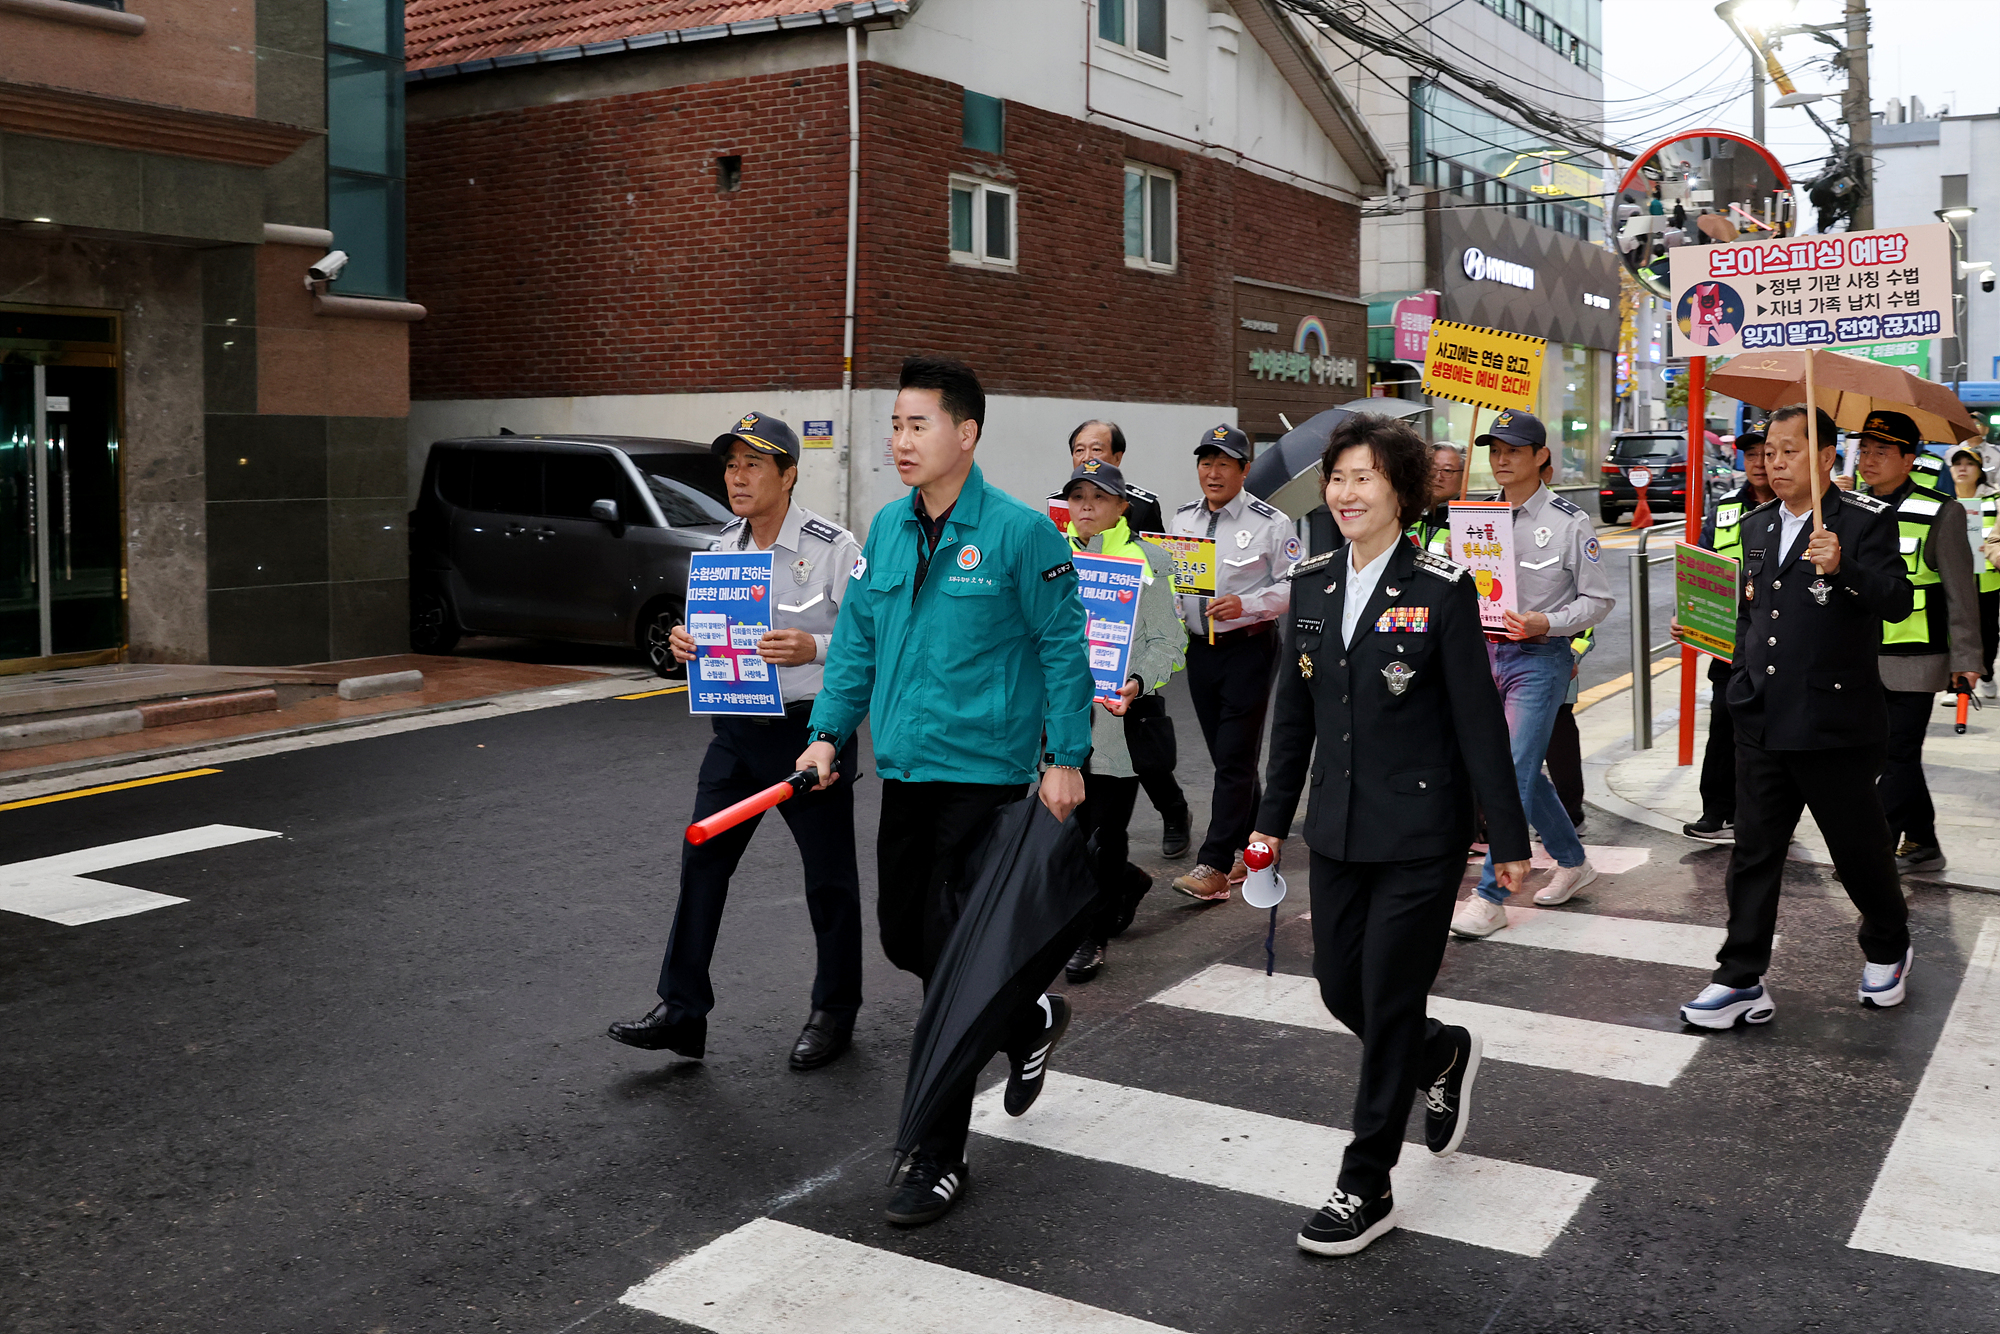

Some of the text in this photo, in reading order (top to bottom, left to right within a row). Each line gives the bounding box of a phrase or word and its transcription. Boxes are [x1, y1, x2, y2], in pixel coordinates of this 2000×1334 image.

[1710, 233, 1908, 277] 보이스피싱 예방
[1486, 257, 1534, 290] HYUNDAI
[1769, 267, 1919, 296] 정부 기관 사칭 수법
[1770, 289, 1920, 317] 자녀 가족 납치 수법
[1742, 310, 1940, 348] 잊지 말고, 전화 끊자!!
[1436, 342, 1478, 364] 사고에는
[1482, 350, 1503, 370] 연습
[1507, 355, 1530, 377] 없고,
[1432, 361, 1531, 396] 생명에는 예비 없다!!
[1160, 540, 1199, 552] 수능캠페인
[1462, 542, 1503, 560] 행복시작
[690, 566, 771, 581] 수험생에게 전하는
[1077, 569, 1141, 588] 생에게 전하는
[688, 587, 750, 601] 따뜻한 메세지
[1083, 587, 1117, 602] 메세지
[698, 693, 775, 705] 도봉구 자율방범연합대
